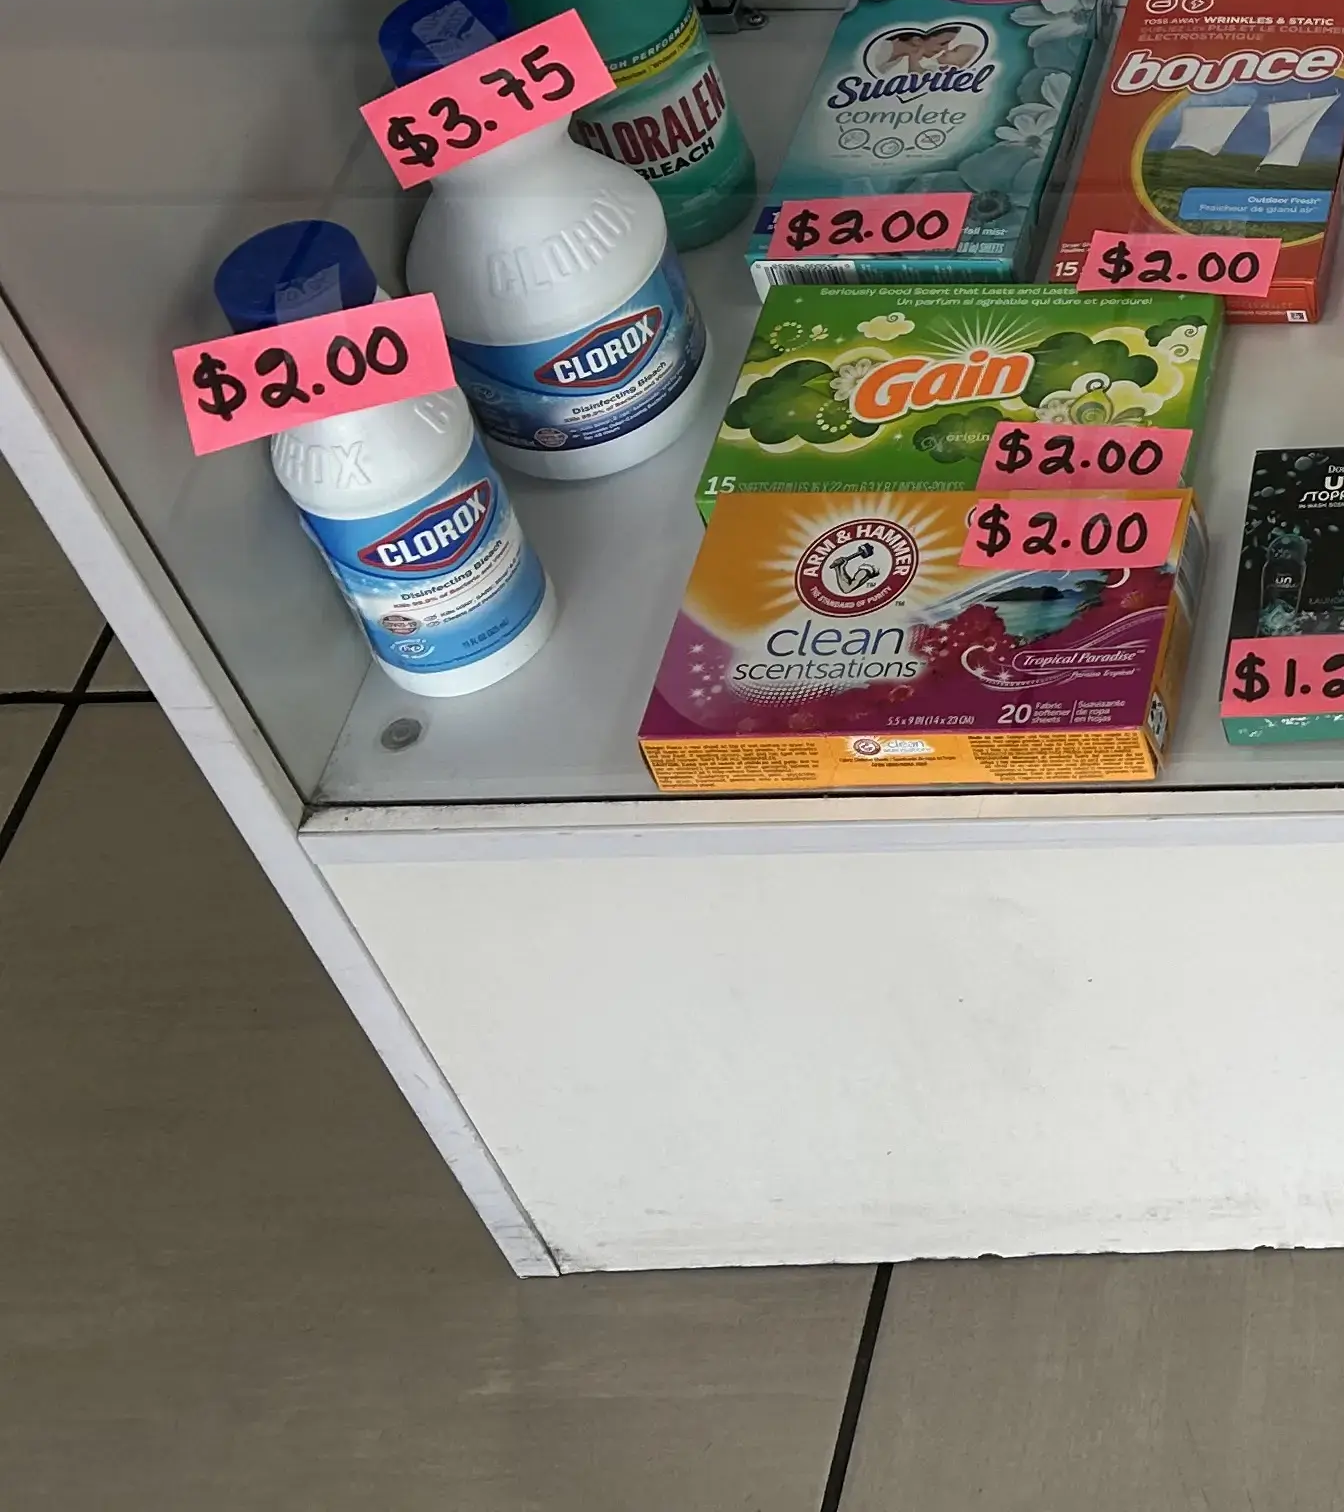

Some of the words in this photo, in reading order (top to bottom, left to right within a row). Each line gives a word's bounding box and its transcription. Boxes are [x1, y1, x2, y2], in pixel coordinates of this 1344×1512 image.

[1204, 16, 1273, 24] WRINKLES
[1289, 17, 1335, 26] STATIC
[828, 64, 995, 109] Suavitel
[1114, 48, 1343, 93] bounce
[388, 45, 575, 167] $3.75
[836, 105, 966, 128] complete
[634, 136, 714, 180] BLEACH
[787, 209, 949, 251] $2.00
[1055, 262, 1078, 277] 15
[1098, 241, 1259, 284] $2.00
[821, 288, 876, 297] Seriously
[879, 288, 911, 296] Good
[913, 288, 948, 296] Scent
[952, 288, 978, 296] that
[554, 314, 654, 383] CLOROX
[193, 326, 409, 420] $2.00
[572, 386, 636, 415] Disinfecting
[638, 361, 666, 386] Bleach
[854, 351, 1032, 420] Gain
[996, 428, 1163, 476] $2.00
[705, 476, 736, 494] 15
[377, 489, 486, 567] CLOROX
[837, 530, 850, 544] &
[856, 525, 911, 576] HAMMER
[976, 503, 1149, 557] $2.00
[401, 569, 472, 601] Disinfecting
[474, 540, 502, 569] Bleach
[766, 620, 904, 656] clean
[733, 657, 918, 680] scentsations
[998, 704, 1031, 723] 20
